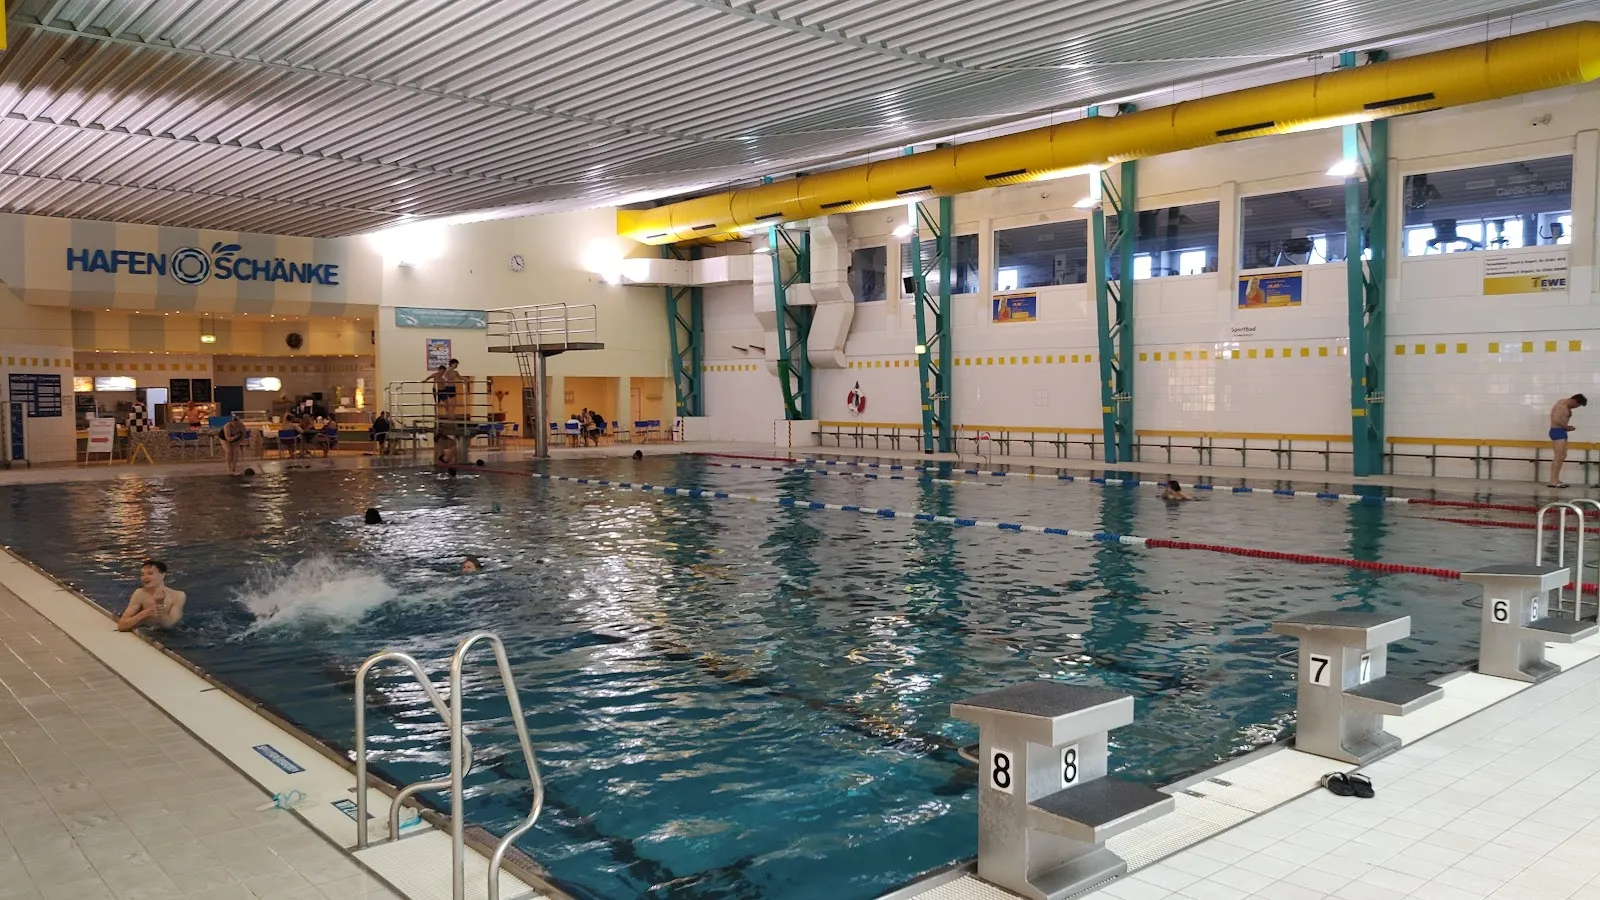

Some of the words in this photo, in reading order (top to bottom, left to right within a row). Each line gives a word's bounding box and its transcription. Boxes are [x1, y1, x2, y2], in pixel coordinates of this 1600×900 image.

[66, 247, 166, 276] HAFEN
[214, 256, 339, 286] SCHÄNKE
[1493, 601, 1508, 621] 6
[1311, 657, 1328, 682] 7
[1361, 655, 1370, 682] 7
[993, 753, 1011, 789] 8
[1064, 748, 1076, 783] 8
